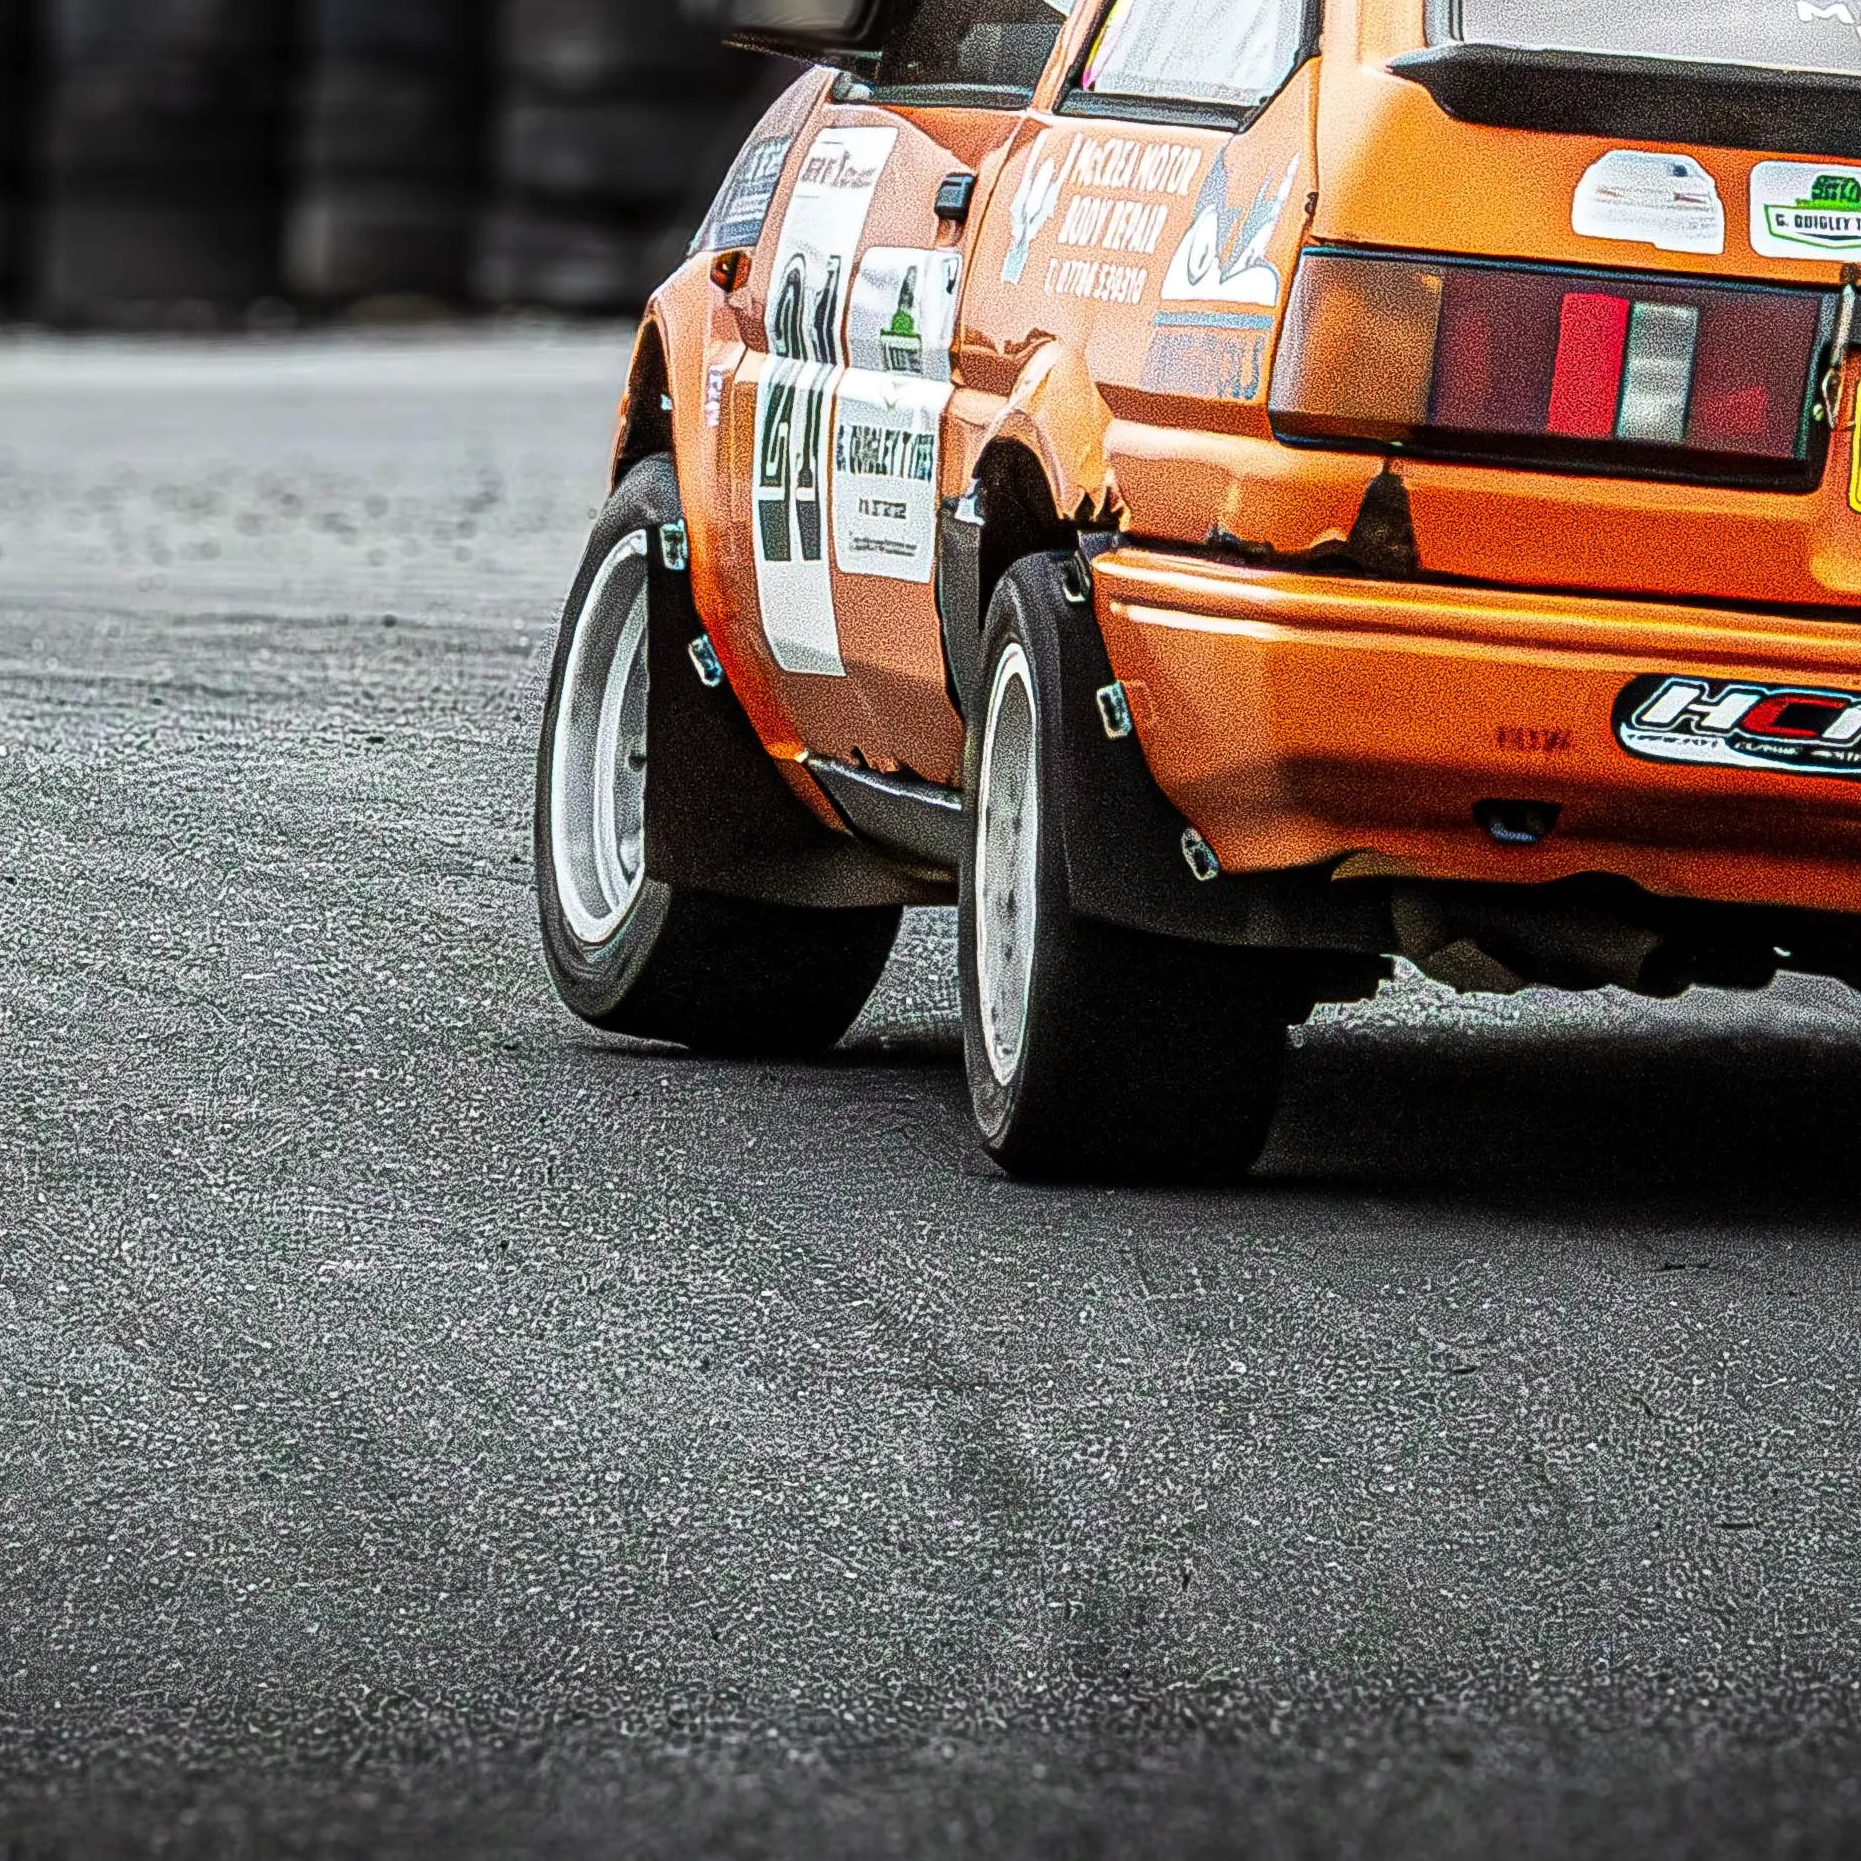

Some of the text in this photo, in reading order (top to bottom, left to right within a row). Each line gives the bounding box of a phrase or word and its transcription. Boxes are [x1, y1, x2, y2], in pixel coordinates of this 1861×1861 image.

[1133, 142, 1202, 196] MOTOR
[1057, 194, 1169, 255] BODY REPAIR
[1794, 214, 1851, 231] QUIGLEY
